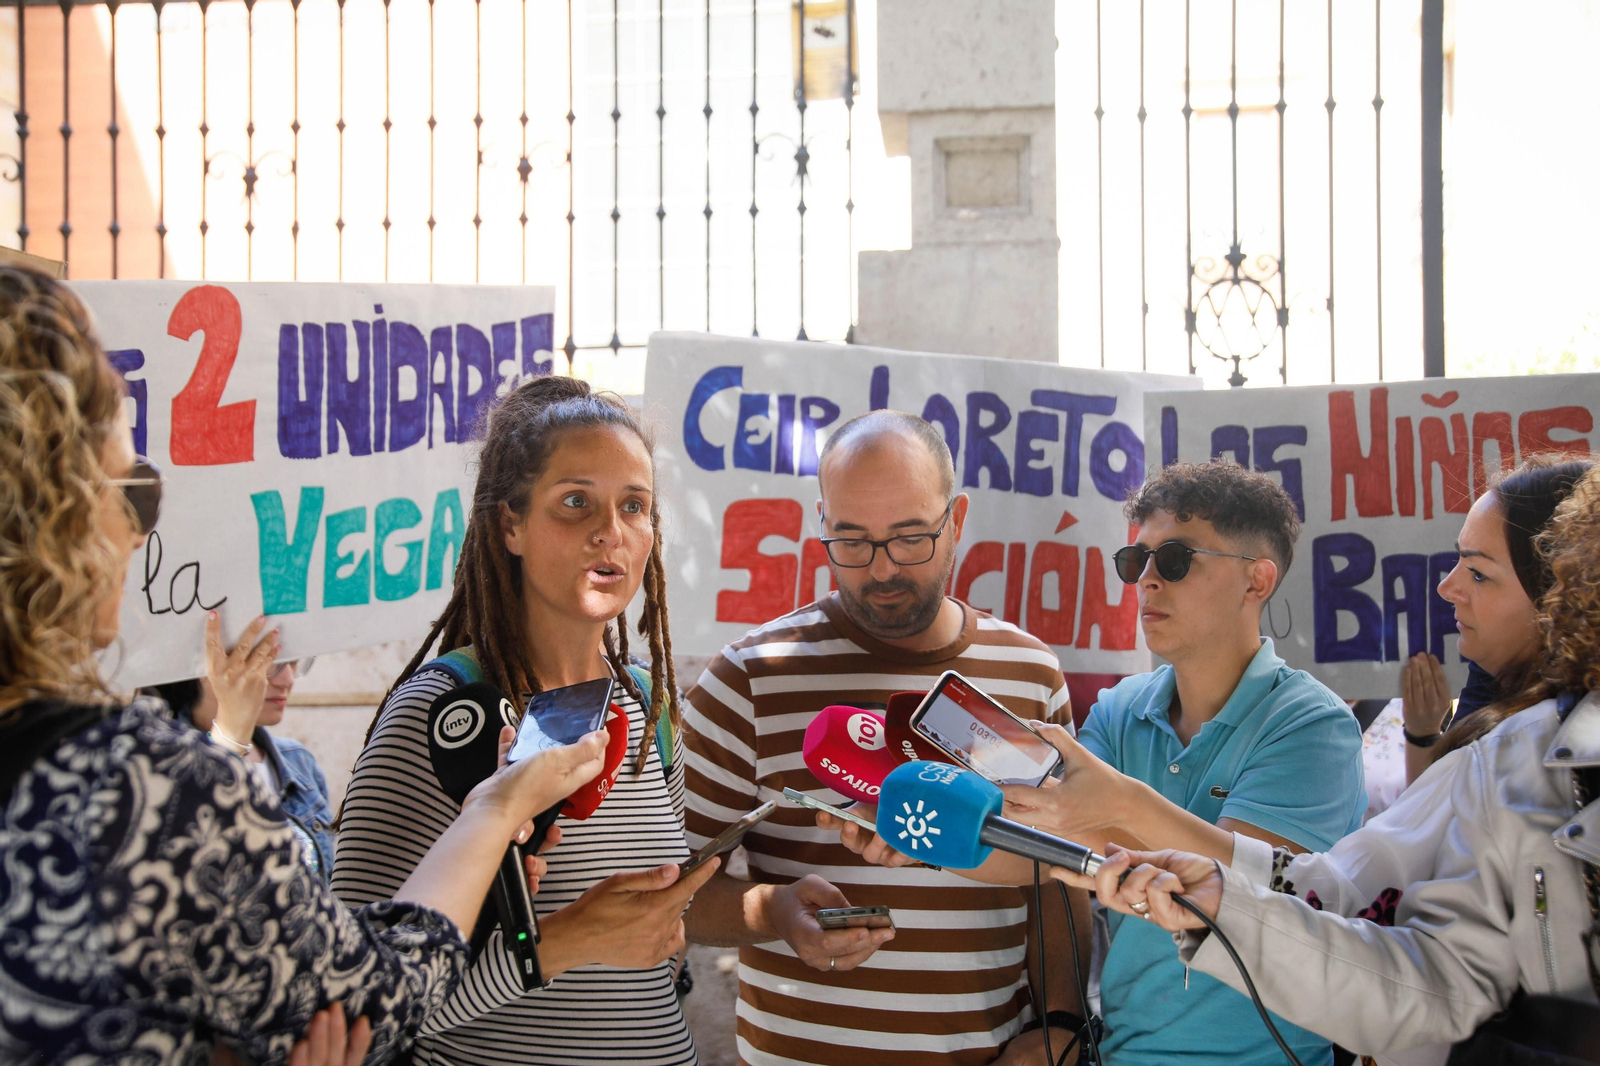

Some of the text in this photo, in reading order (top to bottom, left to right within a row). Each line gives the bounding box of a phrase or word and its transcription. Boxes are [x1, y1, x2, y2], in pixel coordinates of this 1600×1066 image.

[167, 284, 256, 466] 2
[142, 486, 466, 616] la VEGA
[445, 715, 470, 732] intv
[857, 716, 877, 746] 101
[820, 757, 881, 796] 01tv.es
